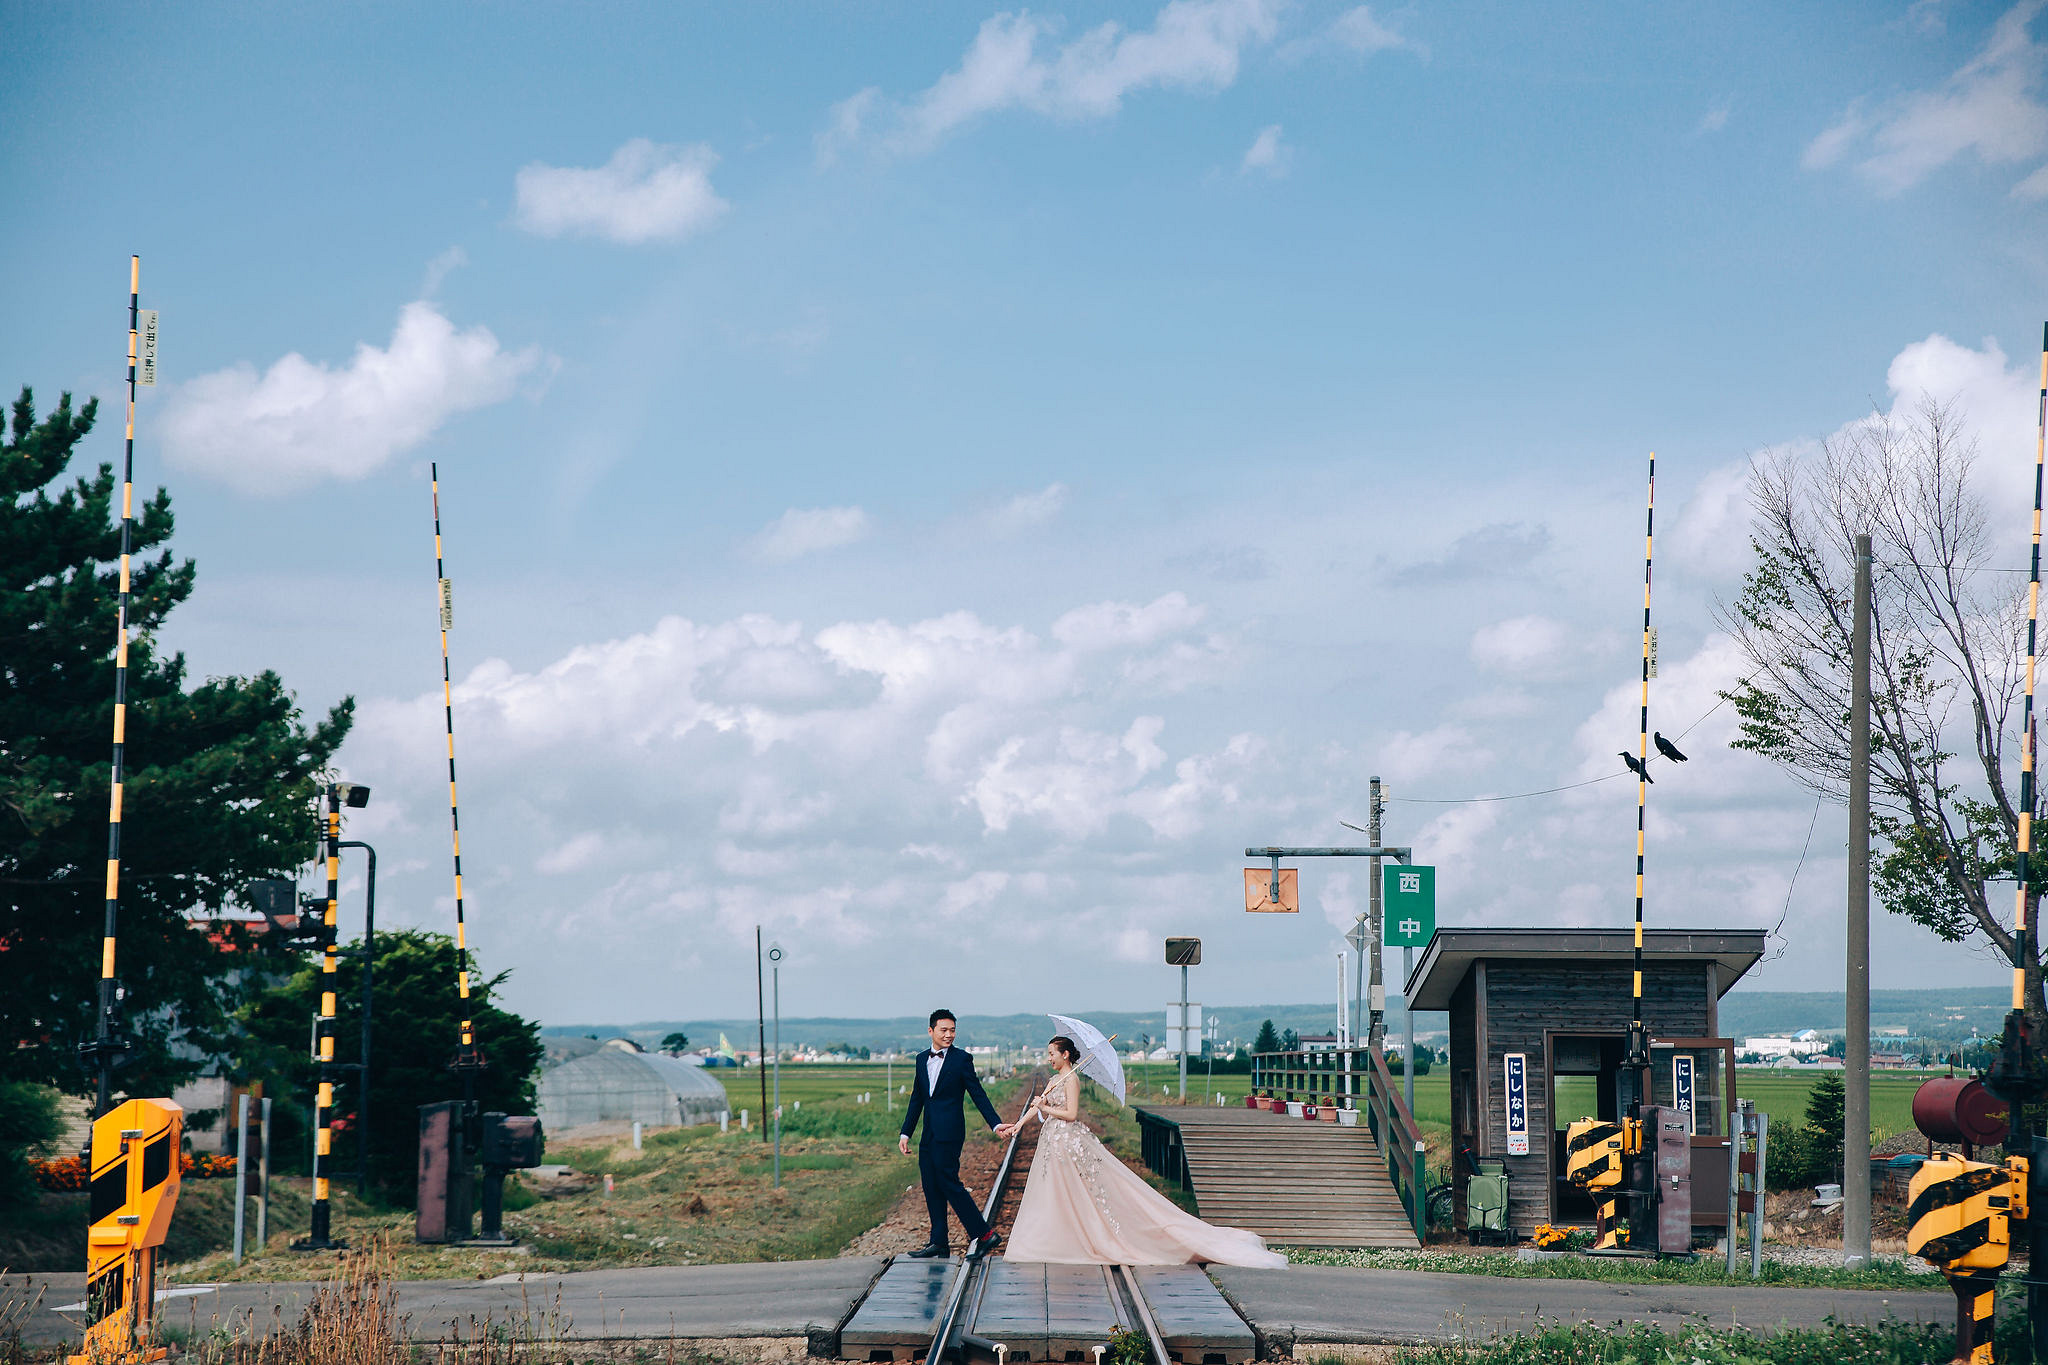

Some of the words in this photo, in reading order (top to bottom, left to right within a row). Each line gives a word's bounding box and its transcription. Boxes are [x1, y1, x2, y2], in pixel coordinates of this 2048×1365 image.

[1510, 1061, 1523, 1128] にしなか
[1678, 1062, 1690, 1111] にしな
